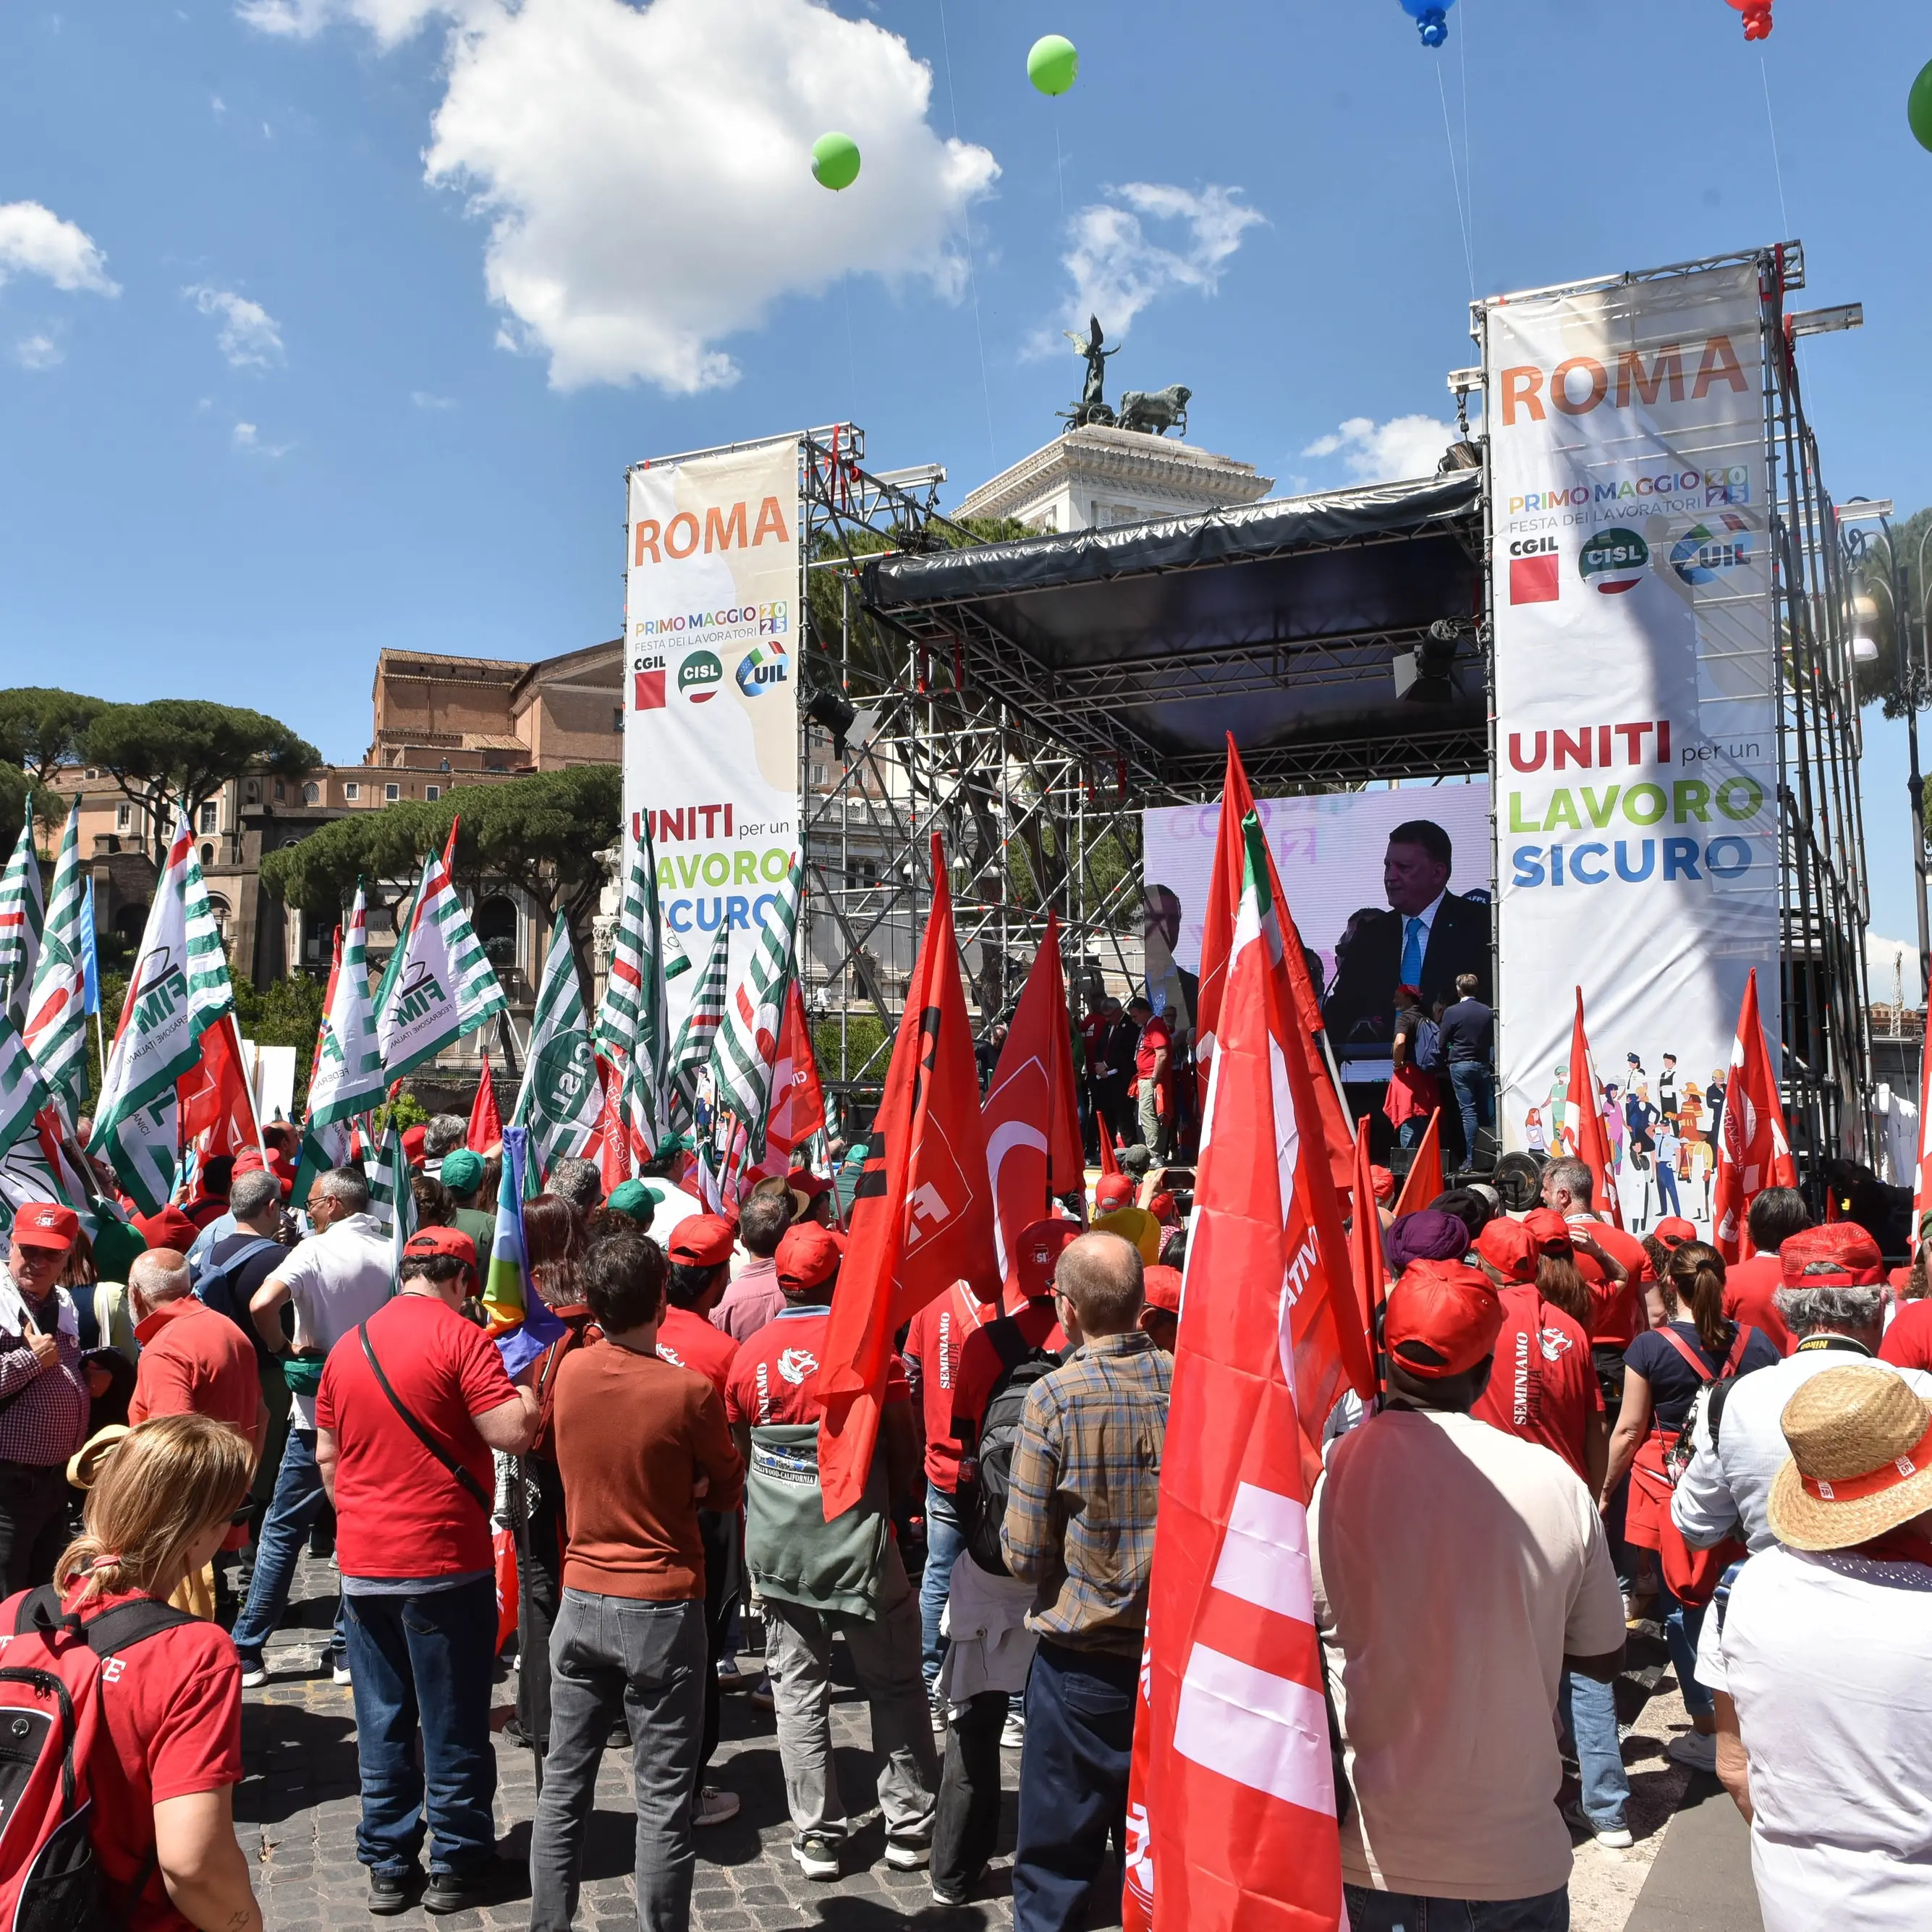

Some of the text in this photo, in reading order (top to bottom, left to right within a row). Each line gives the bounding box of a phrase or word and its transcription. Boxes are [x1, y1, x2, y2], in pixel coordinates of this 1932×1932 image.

[1501, 335, 1748, 426] ROMA
[1509, 471, 1700, 514] PRIMO MAGGIO
[635, 496, 789, 567] ROMA
[1510, 497, 1700, 533] FESTA DEI LAVORATORI
[1510, 536, 1751, 569] CGIL CISL UIL
[635, 627, 757, 652] FESTA DEI LAVORATORI
[636, 606, 756, 637] PRIMO MAGGIO
[635, 656, 787, 685] CGIL CISL UIL
[1509, 720, 1760, 773] UNITI per un
[632, 803, 789, 844] UNITI per un
[1509, 776, 1763, 833] LAVORO
[658, 848, 790, 890] AVORO
[1512, 835, 1753, 888] SICURO
[658, 894, 778, 933] CURO
[940, 1312, 950, 1389] SEMINIAMO
[1800, 1340, 1828, 1350] Nikon
[1514, 1332, 1528, 1425] SEMINIAMO
